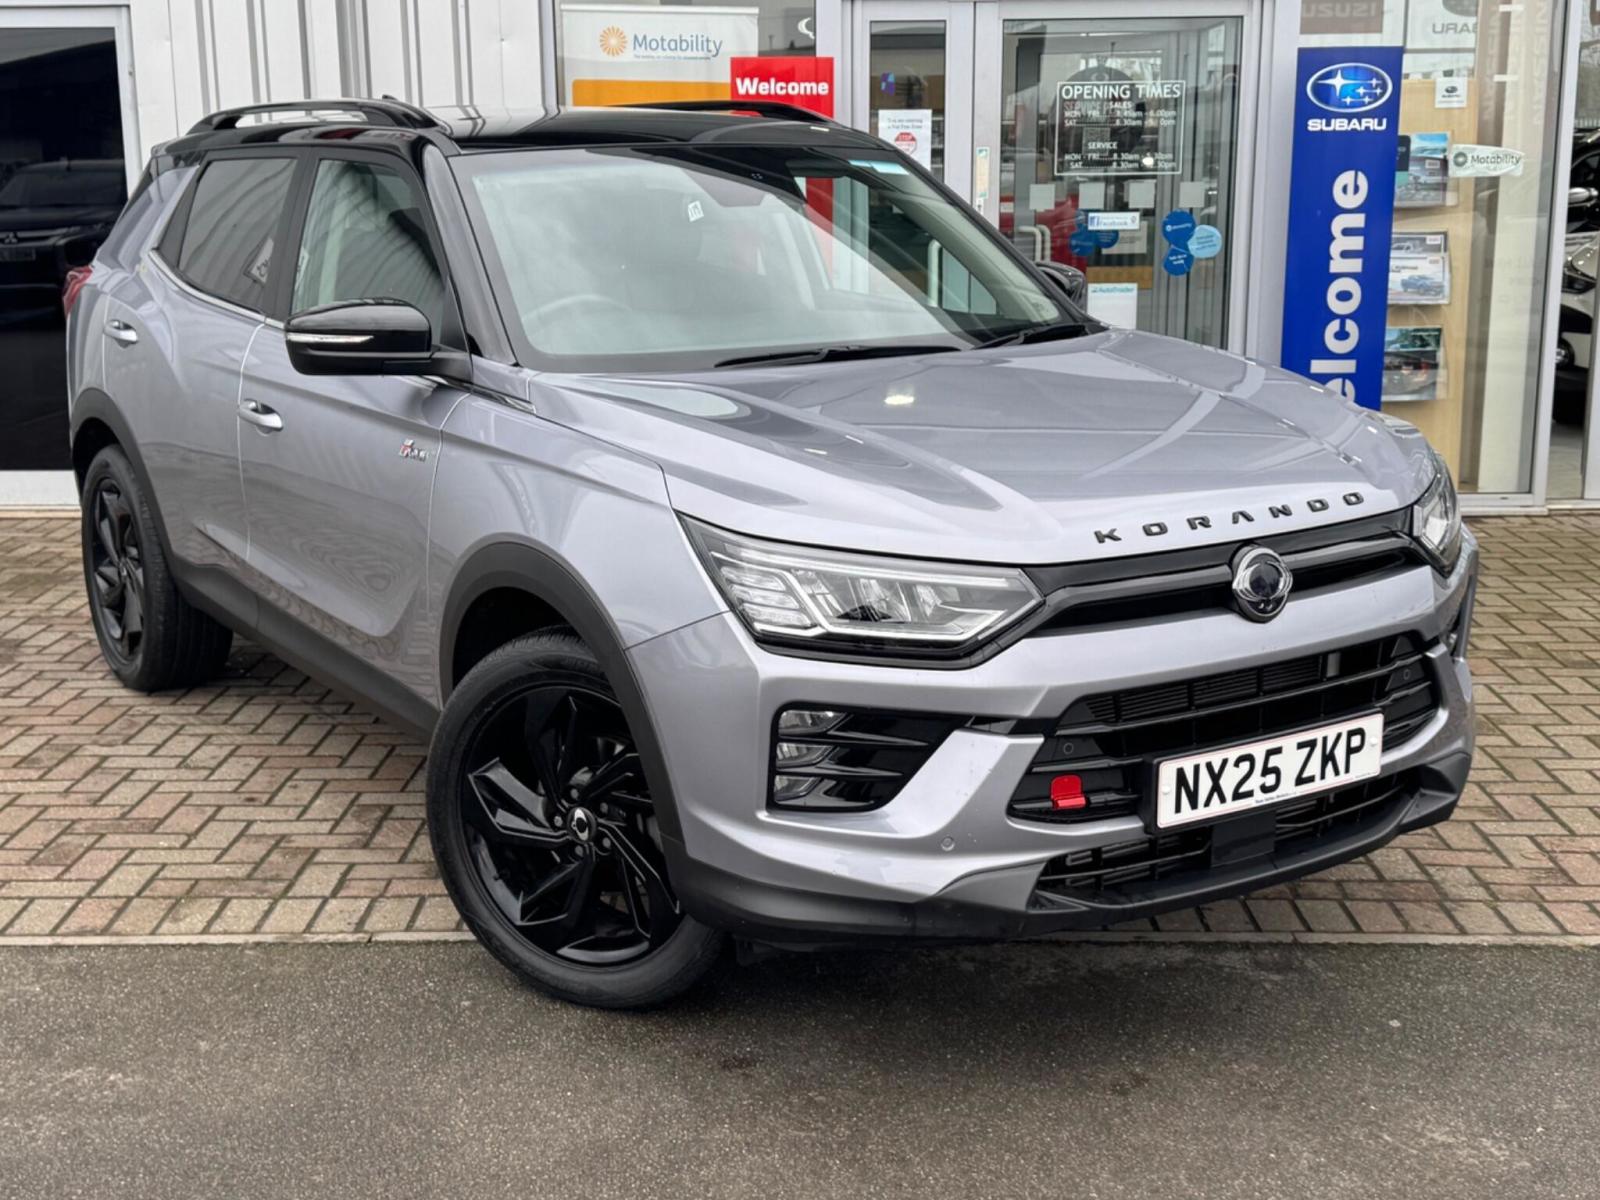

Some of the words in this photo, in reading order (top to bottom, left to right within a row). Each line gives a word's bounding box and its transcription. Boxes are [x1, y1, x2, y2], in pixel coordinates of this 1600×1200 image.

[633, 33, 723, 58] Motability
[736, 77, 829, 96] Welcome
[1061, 84, 1131, 99] OPENING
[1136, 83, 1181, 99] TIMES
[1109, 101, 1132, 109] SALES
[1307, 118, 1387, 132] SUBARU
[1087, 141, 1118, 149] SERVICE
[1470, 154, 1522, 165] Motability
[1309, 170, 1369, 402] elcome
[1094, 492, 1364, 544] KORANDO
[1174, 745, 1283, 814] NX25
[1295, 727, 1366, 787] ZKP
